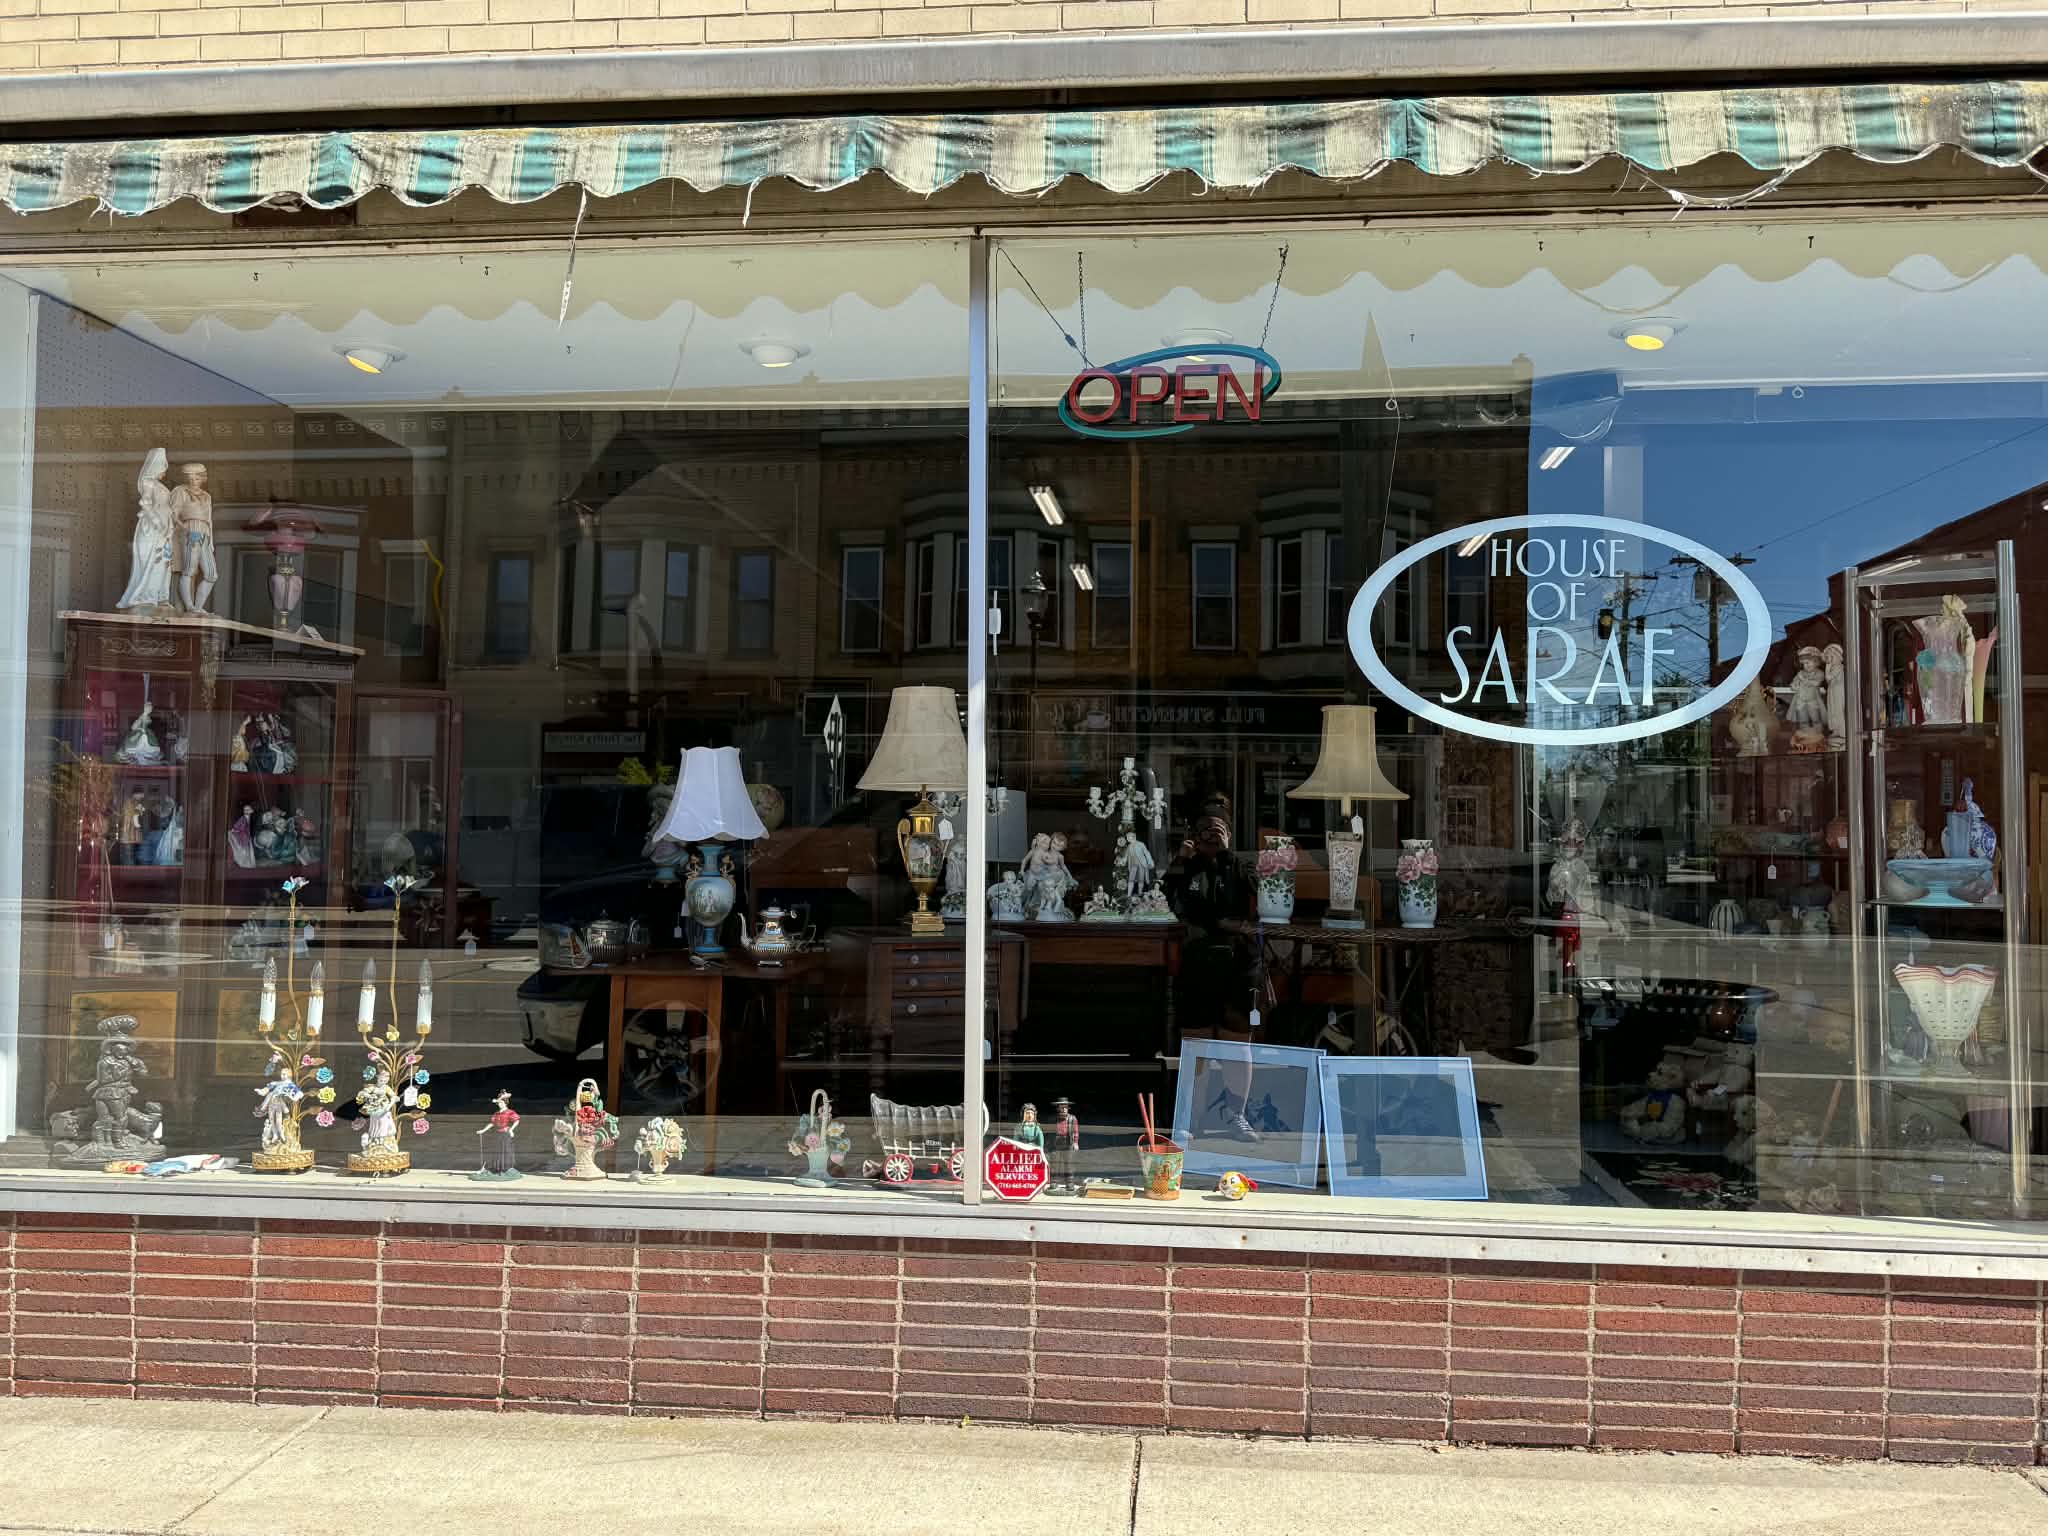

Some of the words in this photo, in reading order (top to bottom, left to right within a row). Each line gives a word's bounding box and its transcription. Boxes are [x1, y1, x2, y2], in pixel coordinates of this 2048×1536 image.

[1068, 362, 1264, 422] OPEN
[1491, 537, 1627, 578] HOUSE
[1526, 582, 1586, 621] OF
[1440, 625, 1675, 706] SARAF
[990, 1152, 1043, 1165] ALLIED
[995, 1172, 1039, 1181] SERVICES
[1001, 1164, 1033, 1173] ALARM
